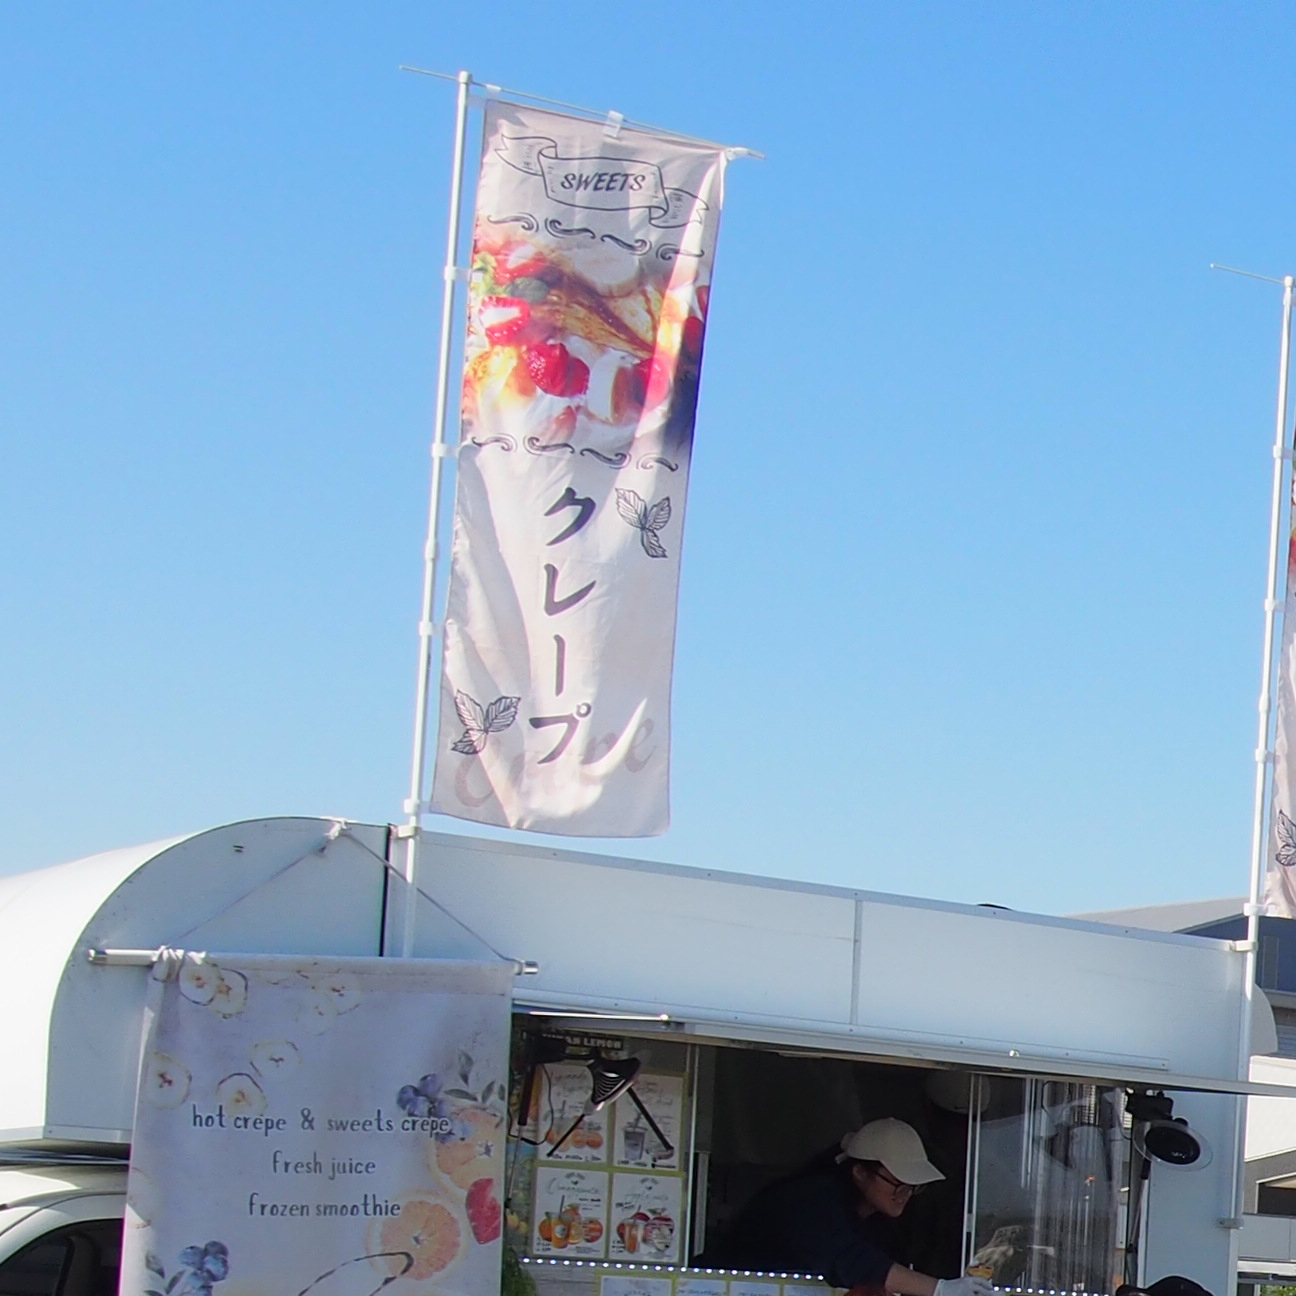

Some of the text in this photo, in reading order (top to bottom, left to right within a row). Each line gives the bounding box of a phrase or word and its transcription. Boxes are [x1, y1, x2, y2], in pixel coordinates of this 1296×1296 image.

[560, 172, 647, 192] SWEETS
[528, 486, 597, 766] クレープ
[192, 1104, 226, 1130] hot
[300, 1108, 316, 1131] &
[327, 1109, 394, 1132] sweets
[272, 1152, 376, 1180] fresh juice
[249, 1192, 401, 1217] frozen smoothie
